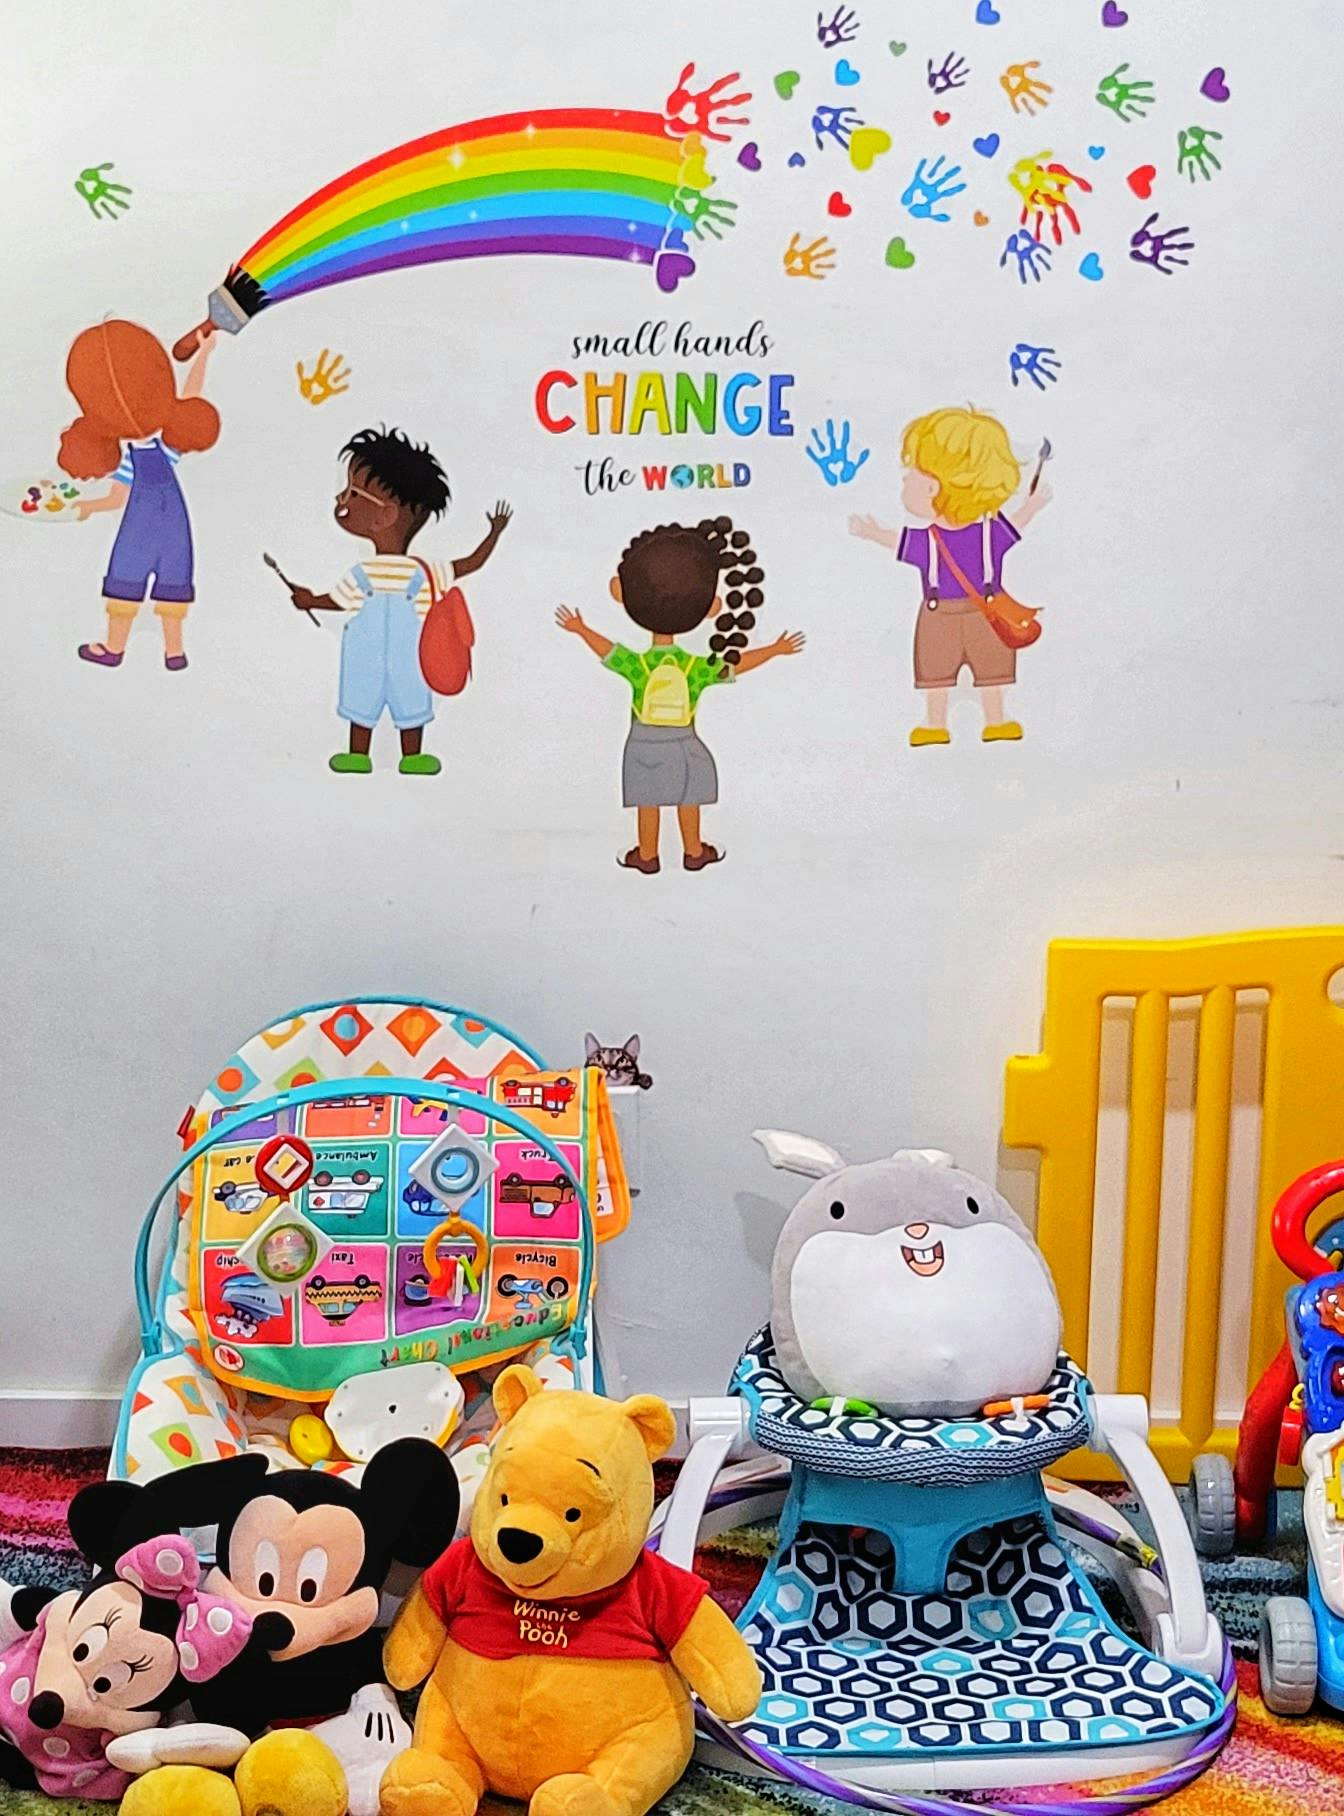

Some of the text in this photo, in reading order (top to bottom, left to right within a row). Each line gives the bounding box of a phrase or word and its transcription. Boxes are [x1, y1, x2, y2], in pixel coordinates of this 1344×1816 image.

[572, 320, 774, 358] small hands
[535, 370, 795, 436] CHANGE
[575, 456, 751, 495] the WORLD
[223, 1156, 242, 1167] car
[315, 1150, 377, 1162] Ambulance
[331, 1252, 355, 1265] Taxi
[515, 1250, 557, 1267] Bicycle
[379, 1339, 439, 1367] Chart
[513, 1599, 581, 1622] Winnie
[519, 1619, 568, 1649] Pooh
